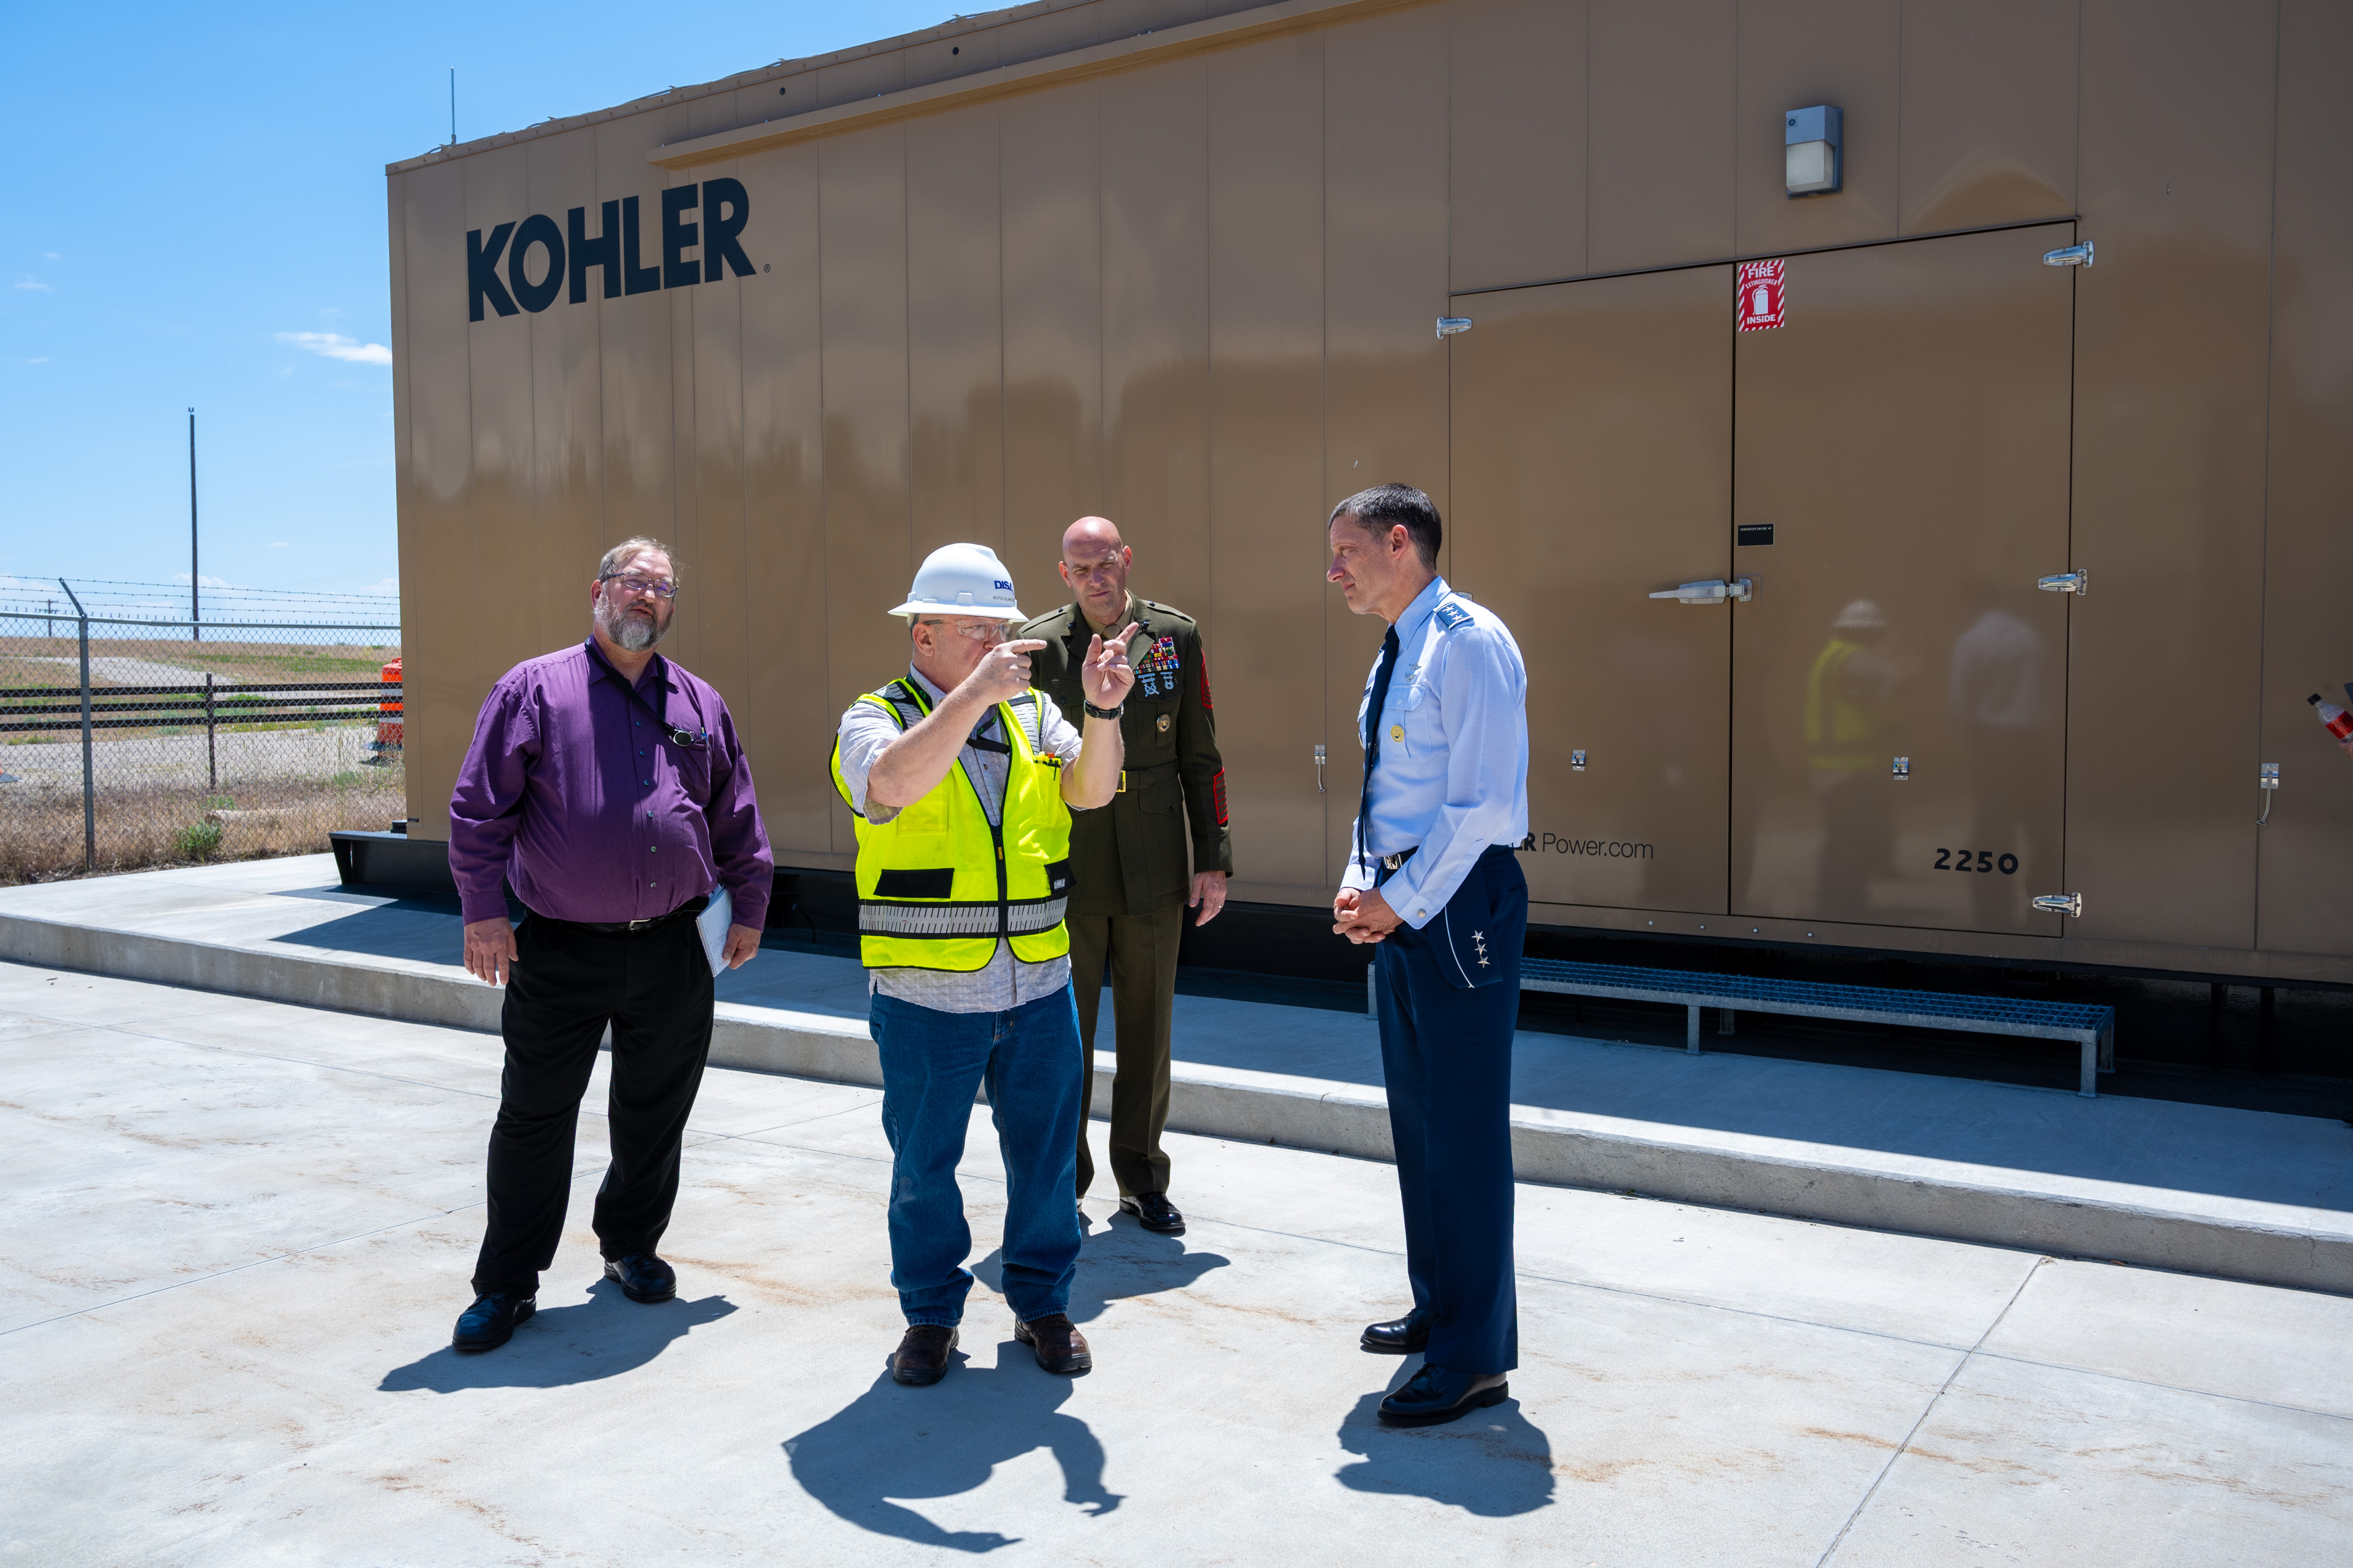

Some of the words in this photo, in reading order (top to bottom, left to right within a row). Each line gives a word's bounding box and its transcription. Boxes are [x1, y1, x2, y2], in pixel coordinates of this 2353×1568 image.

[466, 177, 757, 323] KOHLER
[1748, 266, 1775, 279] FIRE
[1745, 278, 1778, 289] EXTINGUISHER
[1747, 314, 1776, 324] INSIDE
[1542, 833, 1654, 859] Power.com
[1934, 848, 2019, 875] 2250
